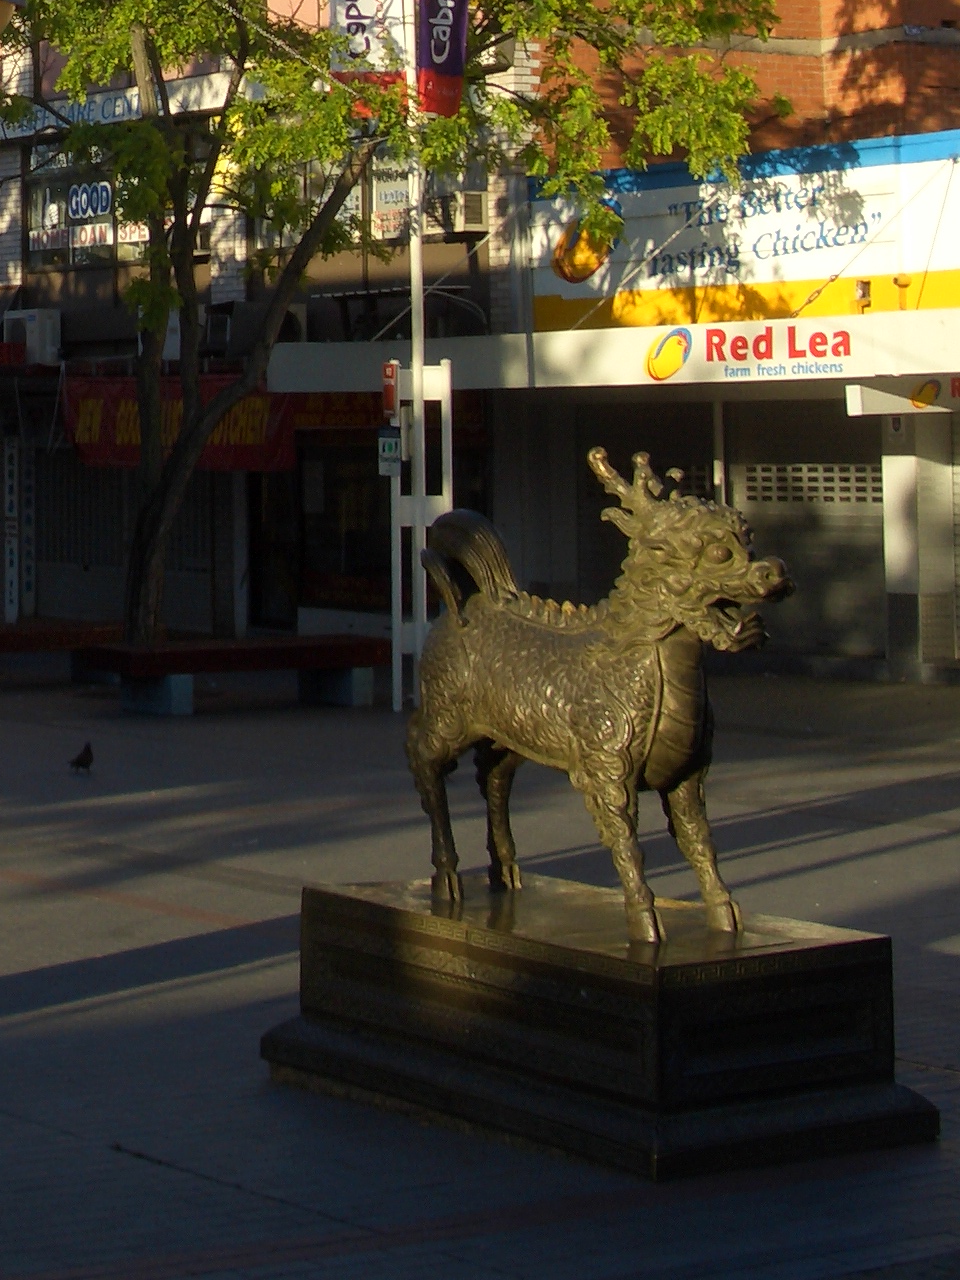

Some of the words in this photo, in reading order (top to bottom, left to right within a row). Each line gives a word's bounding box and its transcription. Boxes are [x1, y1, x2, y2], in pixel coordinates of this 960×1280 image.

[68, 181, 112, 219] GOOD
[739, 185, 824, 219] Better
[30, 228, 68, 250] HOME
[706, 326, 773, 362] Red
[787, 325, 851, 359] Lea
[724, 365, 751, 378] farm
[757, 363, 786, 376] fresh
[792, 361, 843, 375] chickens
